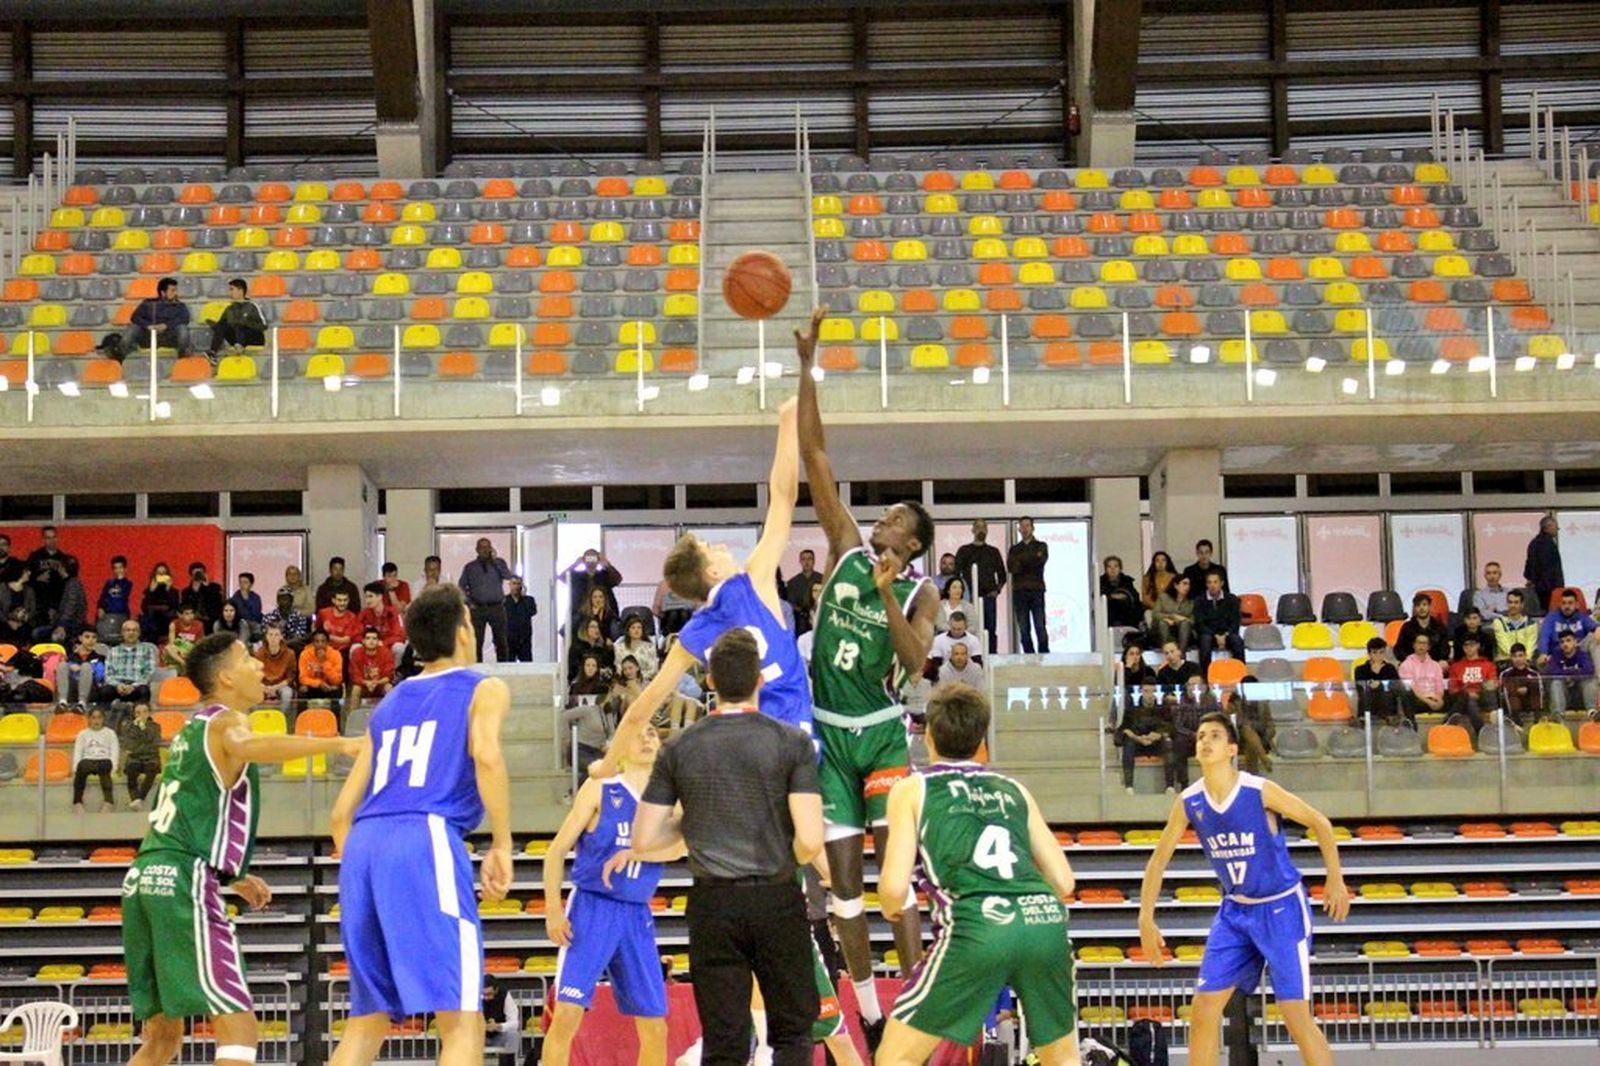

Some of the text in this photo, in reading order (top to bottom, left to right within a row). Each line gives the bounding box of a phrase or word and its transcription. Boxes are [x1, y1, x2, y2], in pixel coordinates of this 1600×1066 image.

[833, 639, 860, 671] 13
[372, 720, 438, 796] 14
[947, 779, 1017, 819] Málaga
[972, 824, 1018, 879] 4
[1206, 831, 1255, 850] UCAM
[143, 864, 178, 877] COSTA
[156, 876, 177, 887] SOL
[1226, 860, 1248, 885] 17
[1016, 893, 1057, 906] COSTA
[1021, 906, 1044, 916] DEL
